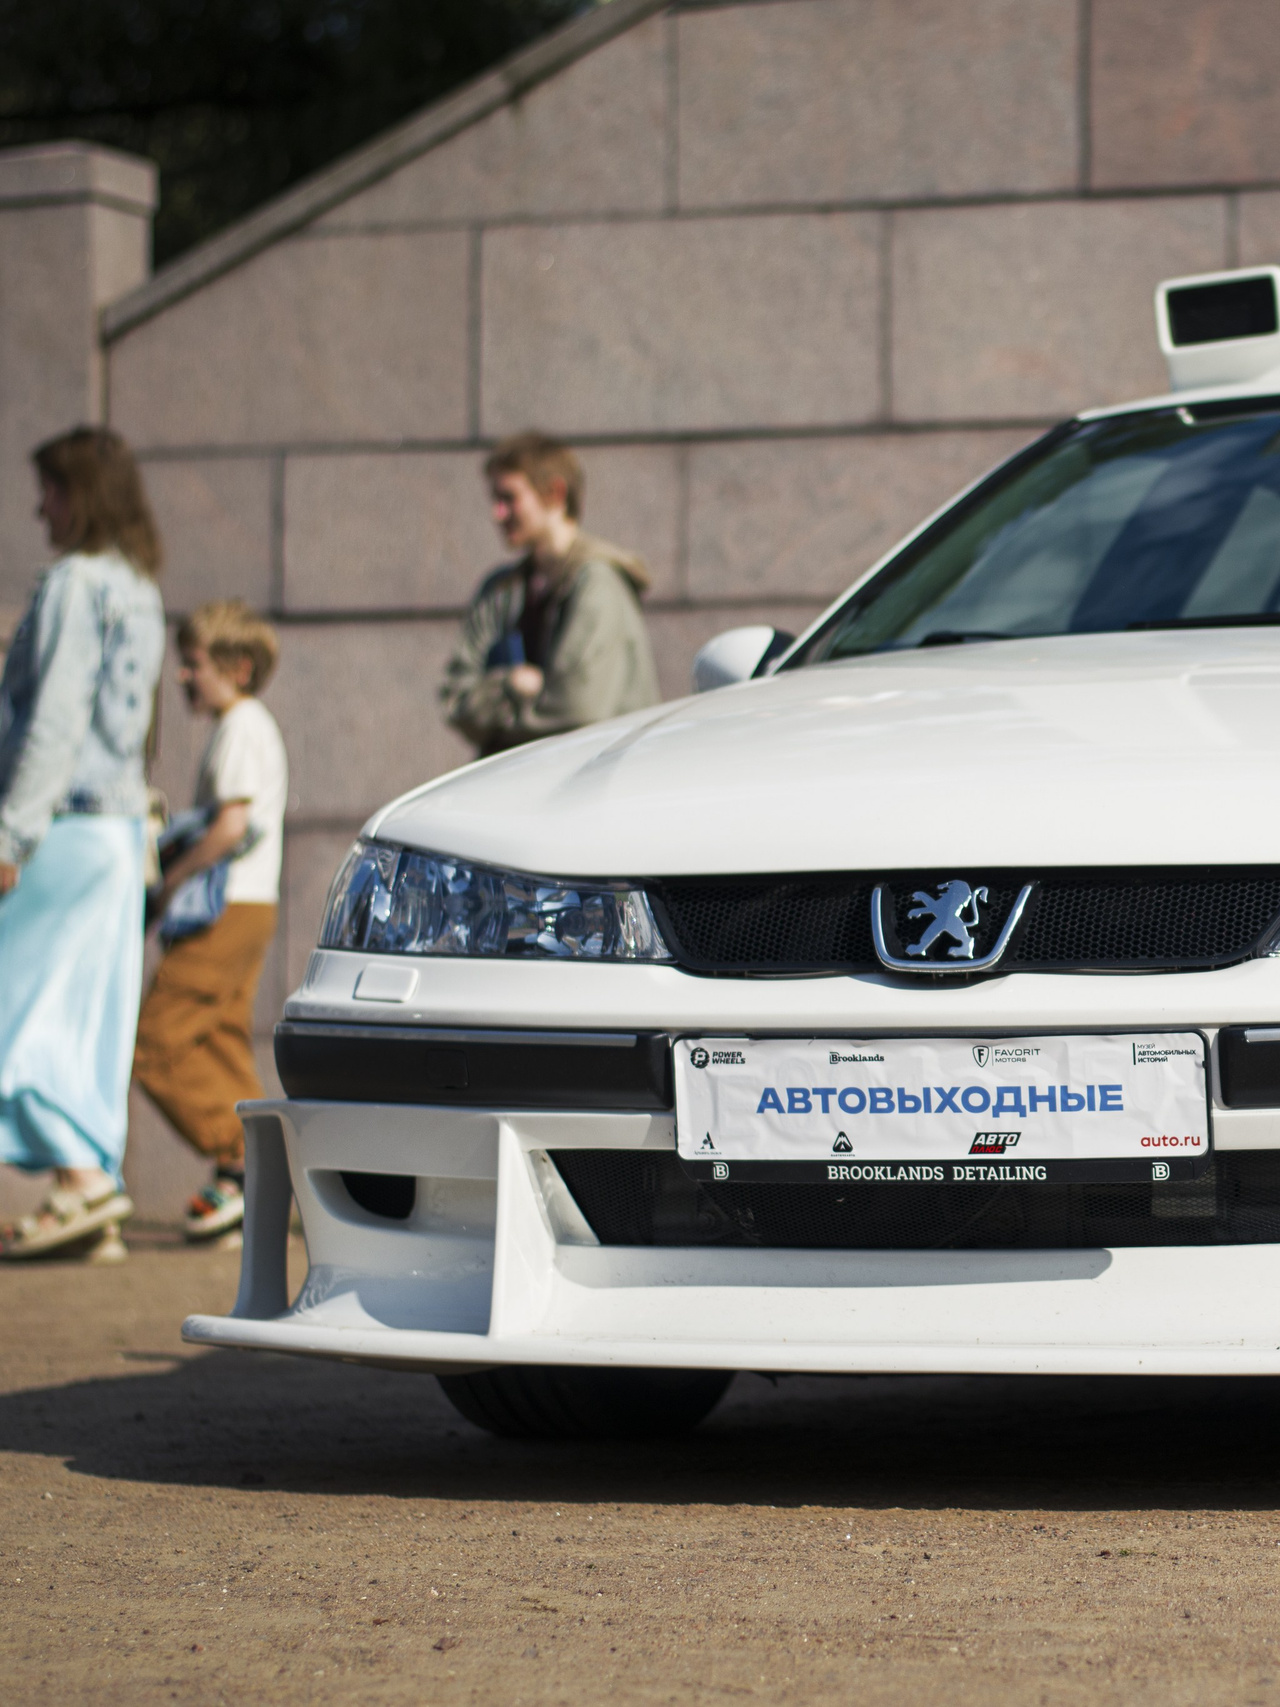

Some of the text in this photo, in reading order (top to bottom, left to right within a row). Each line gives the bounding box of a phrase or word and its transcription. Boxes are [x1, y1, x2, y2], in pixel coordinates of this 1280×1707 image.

[830, 1052, 885, 1063] Brooklands
[995, 1048, 1041, 1056] FAVORIT
[756, 1084, 1125, 1118] АВТОВЫХОДНЫЕ
[974, 1133, 1018, 1146] АВТО
[1140, 1135, 1201, 1147] auto.ru
[971, 1145, 1003, 1153] ПЛЮС
[827, 1165, 1047, 1180] BROOKLANDS DETAILING
